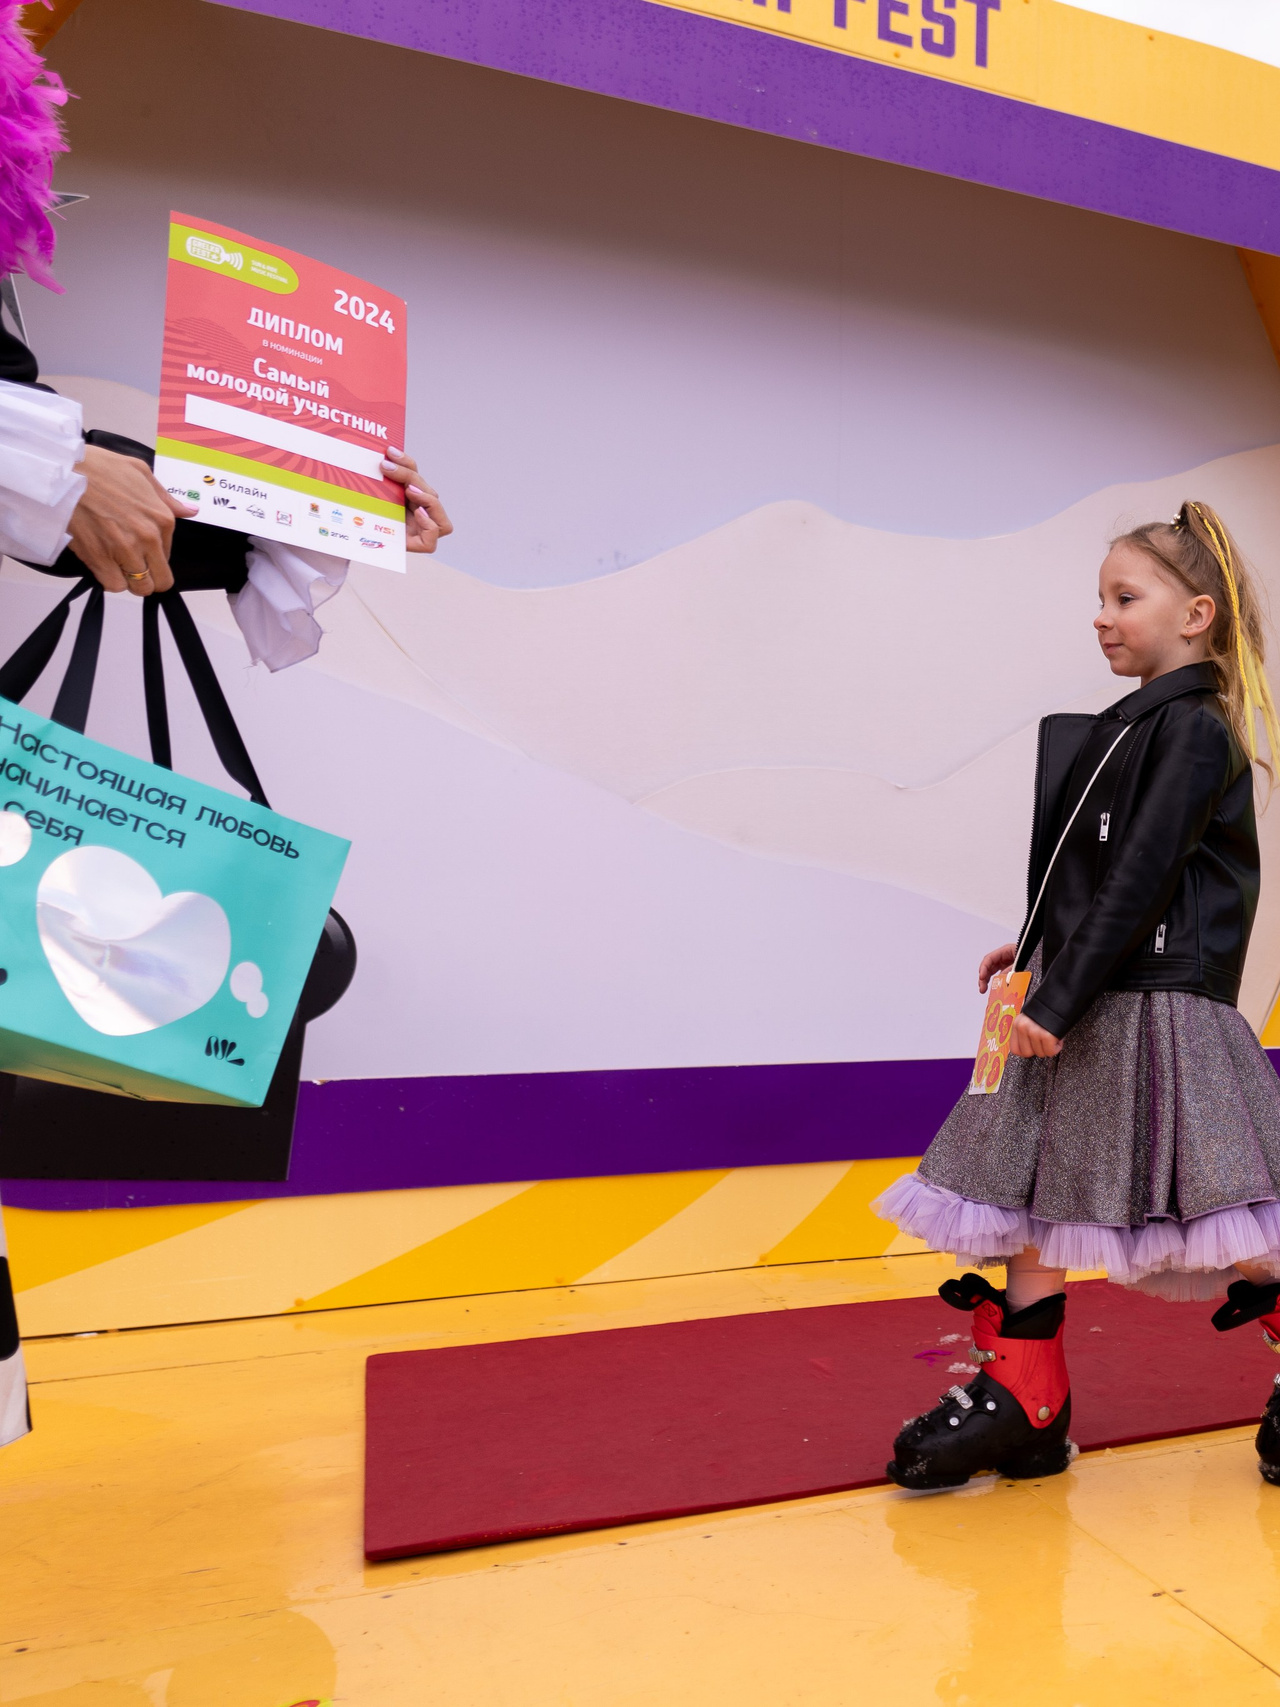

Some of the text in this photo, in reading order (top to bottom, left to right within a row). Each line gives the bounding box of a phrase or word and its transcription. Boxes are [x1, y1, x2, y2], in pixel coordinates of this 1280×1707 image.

[247, 307, 343, 356] ДИПЛОМ
[333, 288, 396, 335] 2024
[262, 339, 323, 366] в номинации
[253, 357, 330, 399] Самый
[186, 363, 388, 440] молодой участник
[219, 479, 268, 500] билайн
